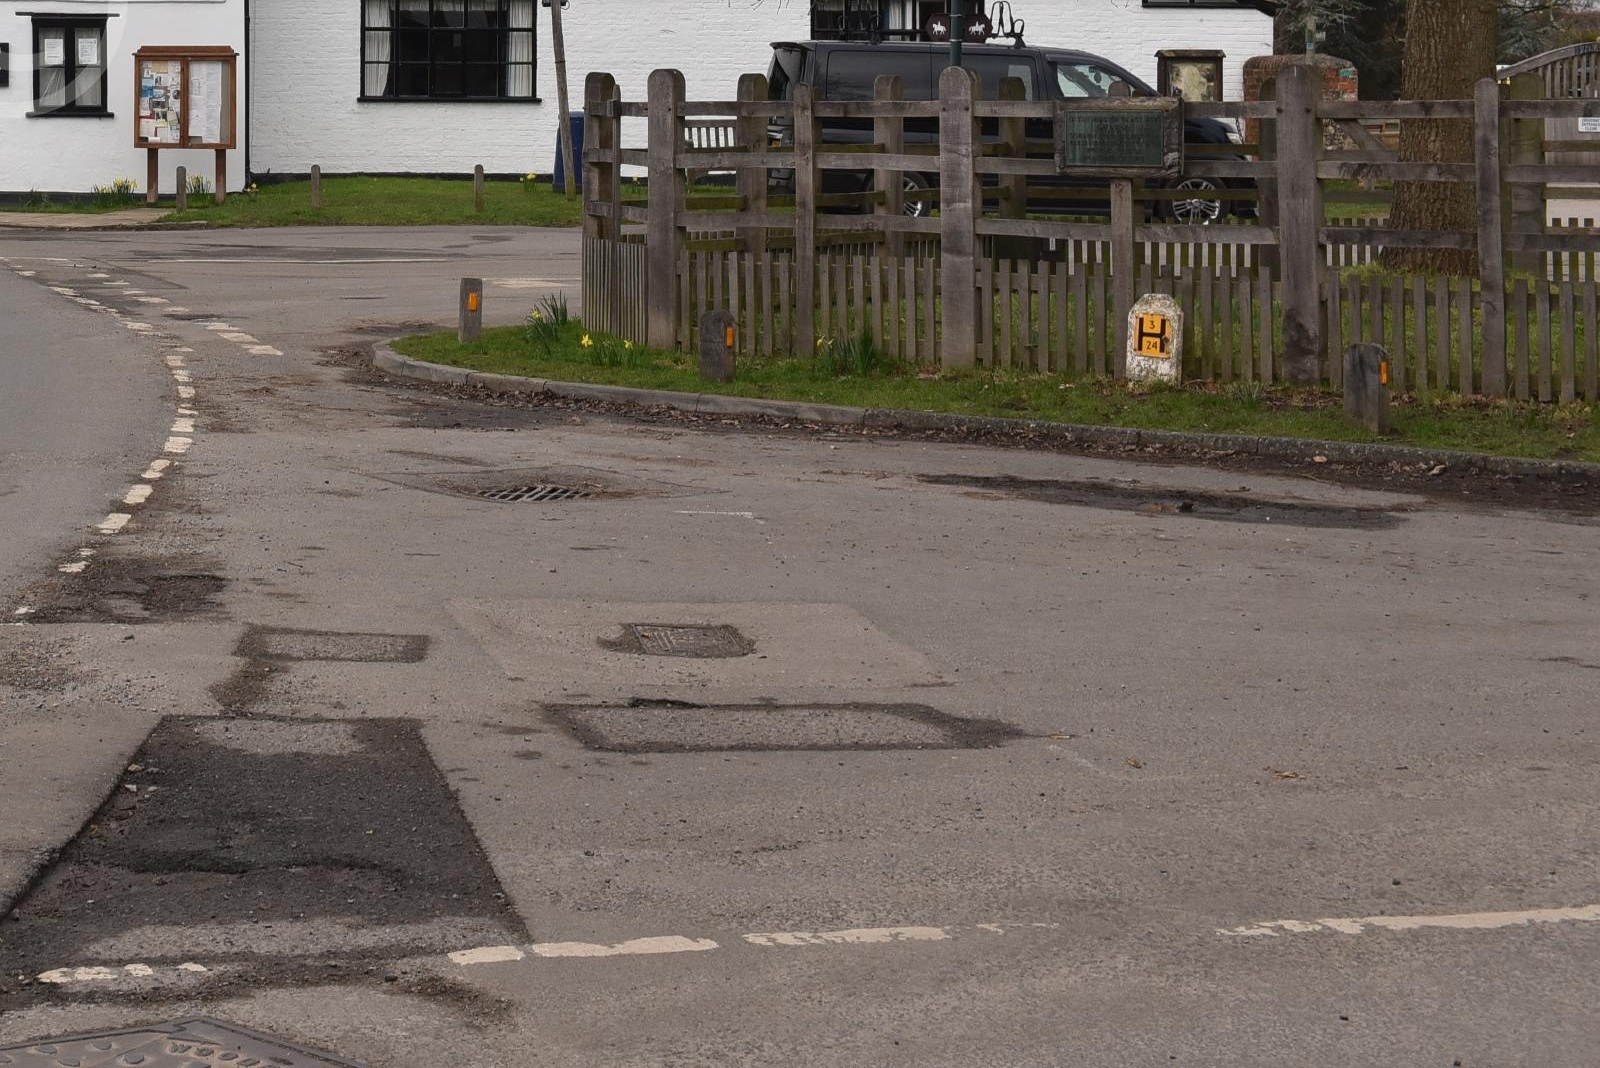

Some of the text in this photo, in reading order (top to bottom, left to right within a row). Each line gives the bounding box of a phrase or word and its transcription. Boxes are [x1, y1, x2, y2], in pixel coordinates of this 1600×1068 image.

[1148, 320, 1156, 330] 3
[1137, 316, 1167, 353] H
[1145, 340, 1158, 351] 24
